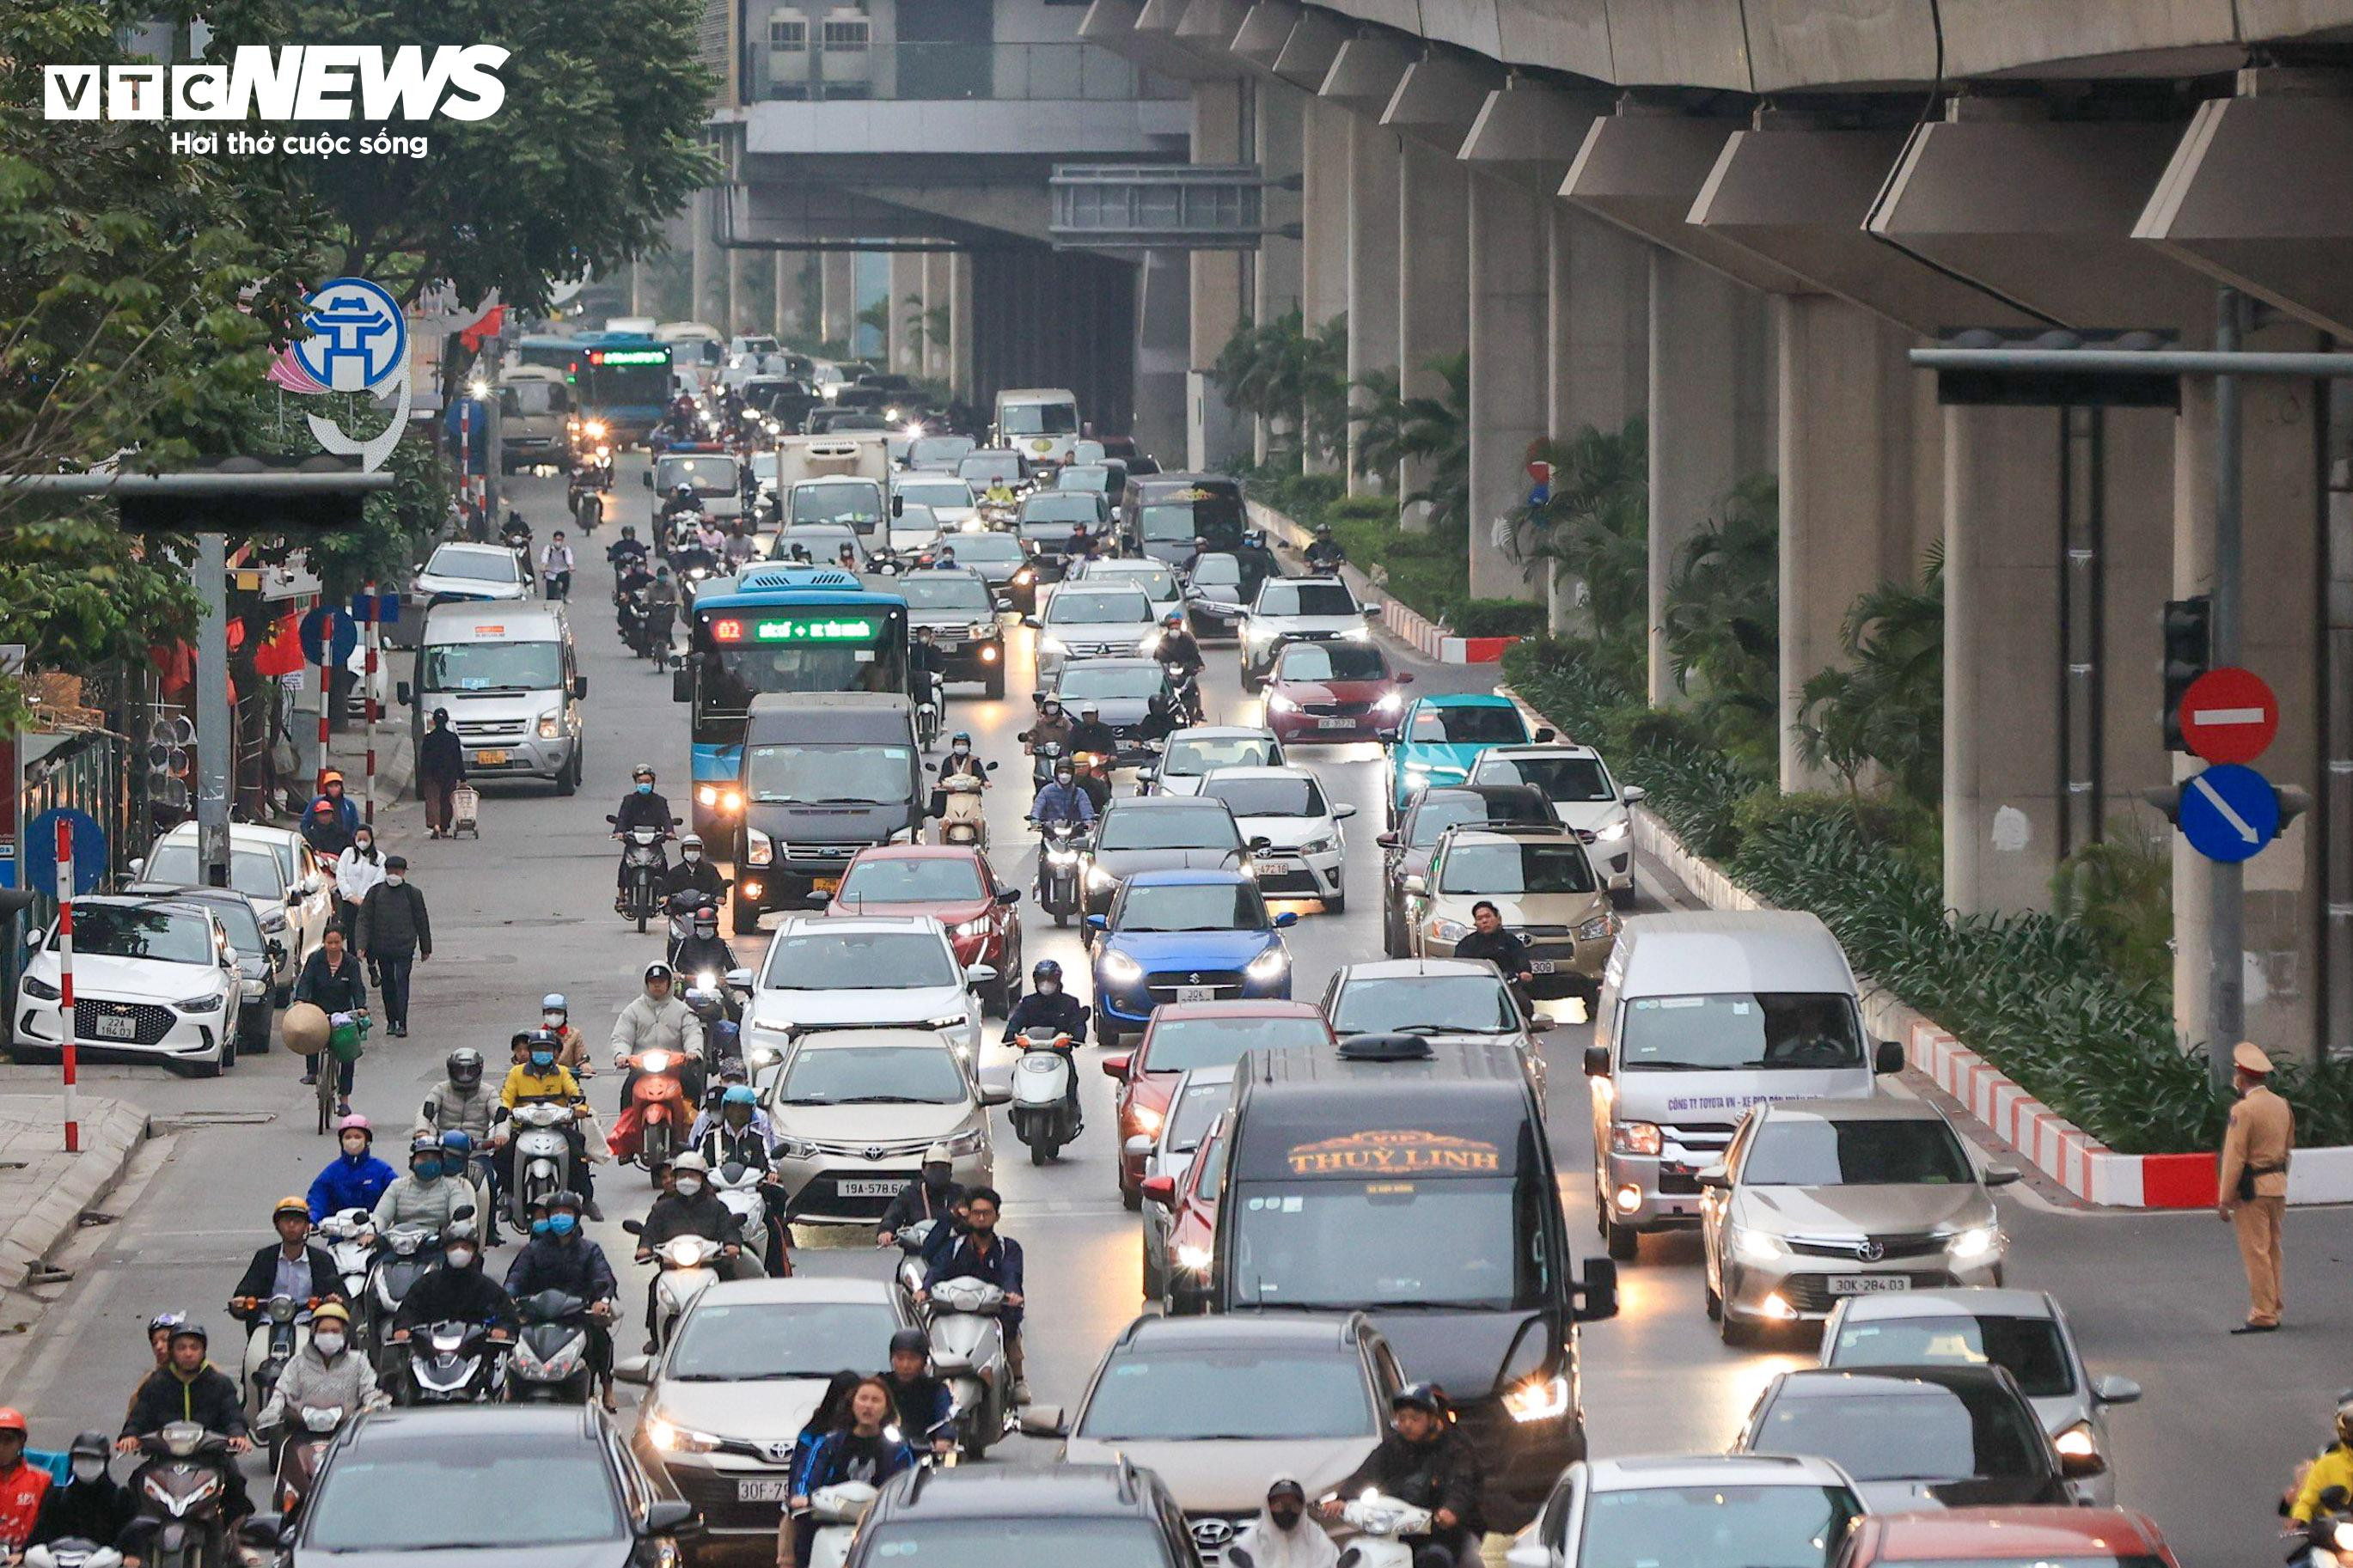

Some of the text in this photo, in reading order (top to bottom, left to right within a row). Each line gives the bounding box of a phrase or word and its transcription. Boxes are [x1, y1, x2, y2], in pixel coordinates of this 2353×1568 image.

[717, 620, 741, 638] 02
[108, 1018, 125, 1027] 22A
[1699, 1096, 1724, 1109] TOYOTA
[1727, 1095, 1736, 1108] VN
[1742, 1095, 1752, 1107] XE
[1405, 1149, 1500, 1171] LINH
